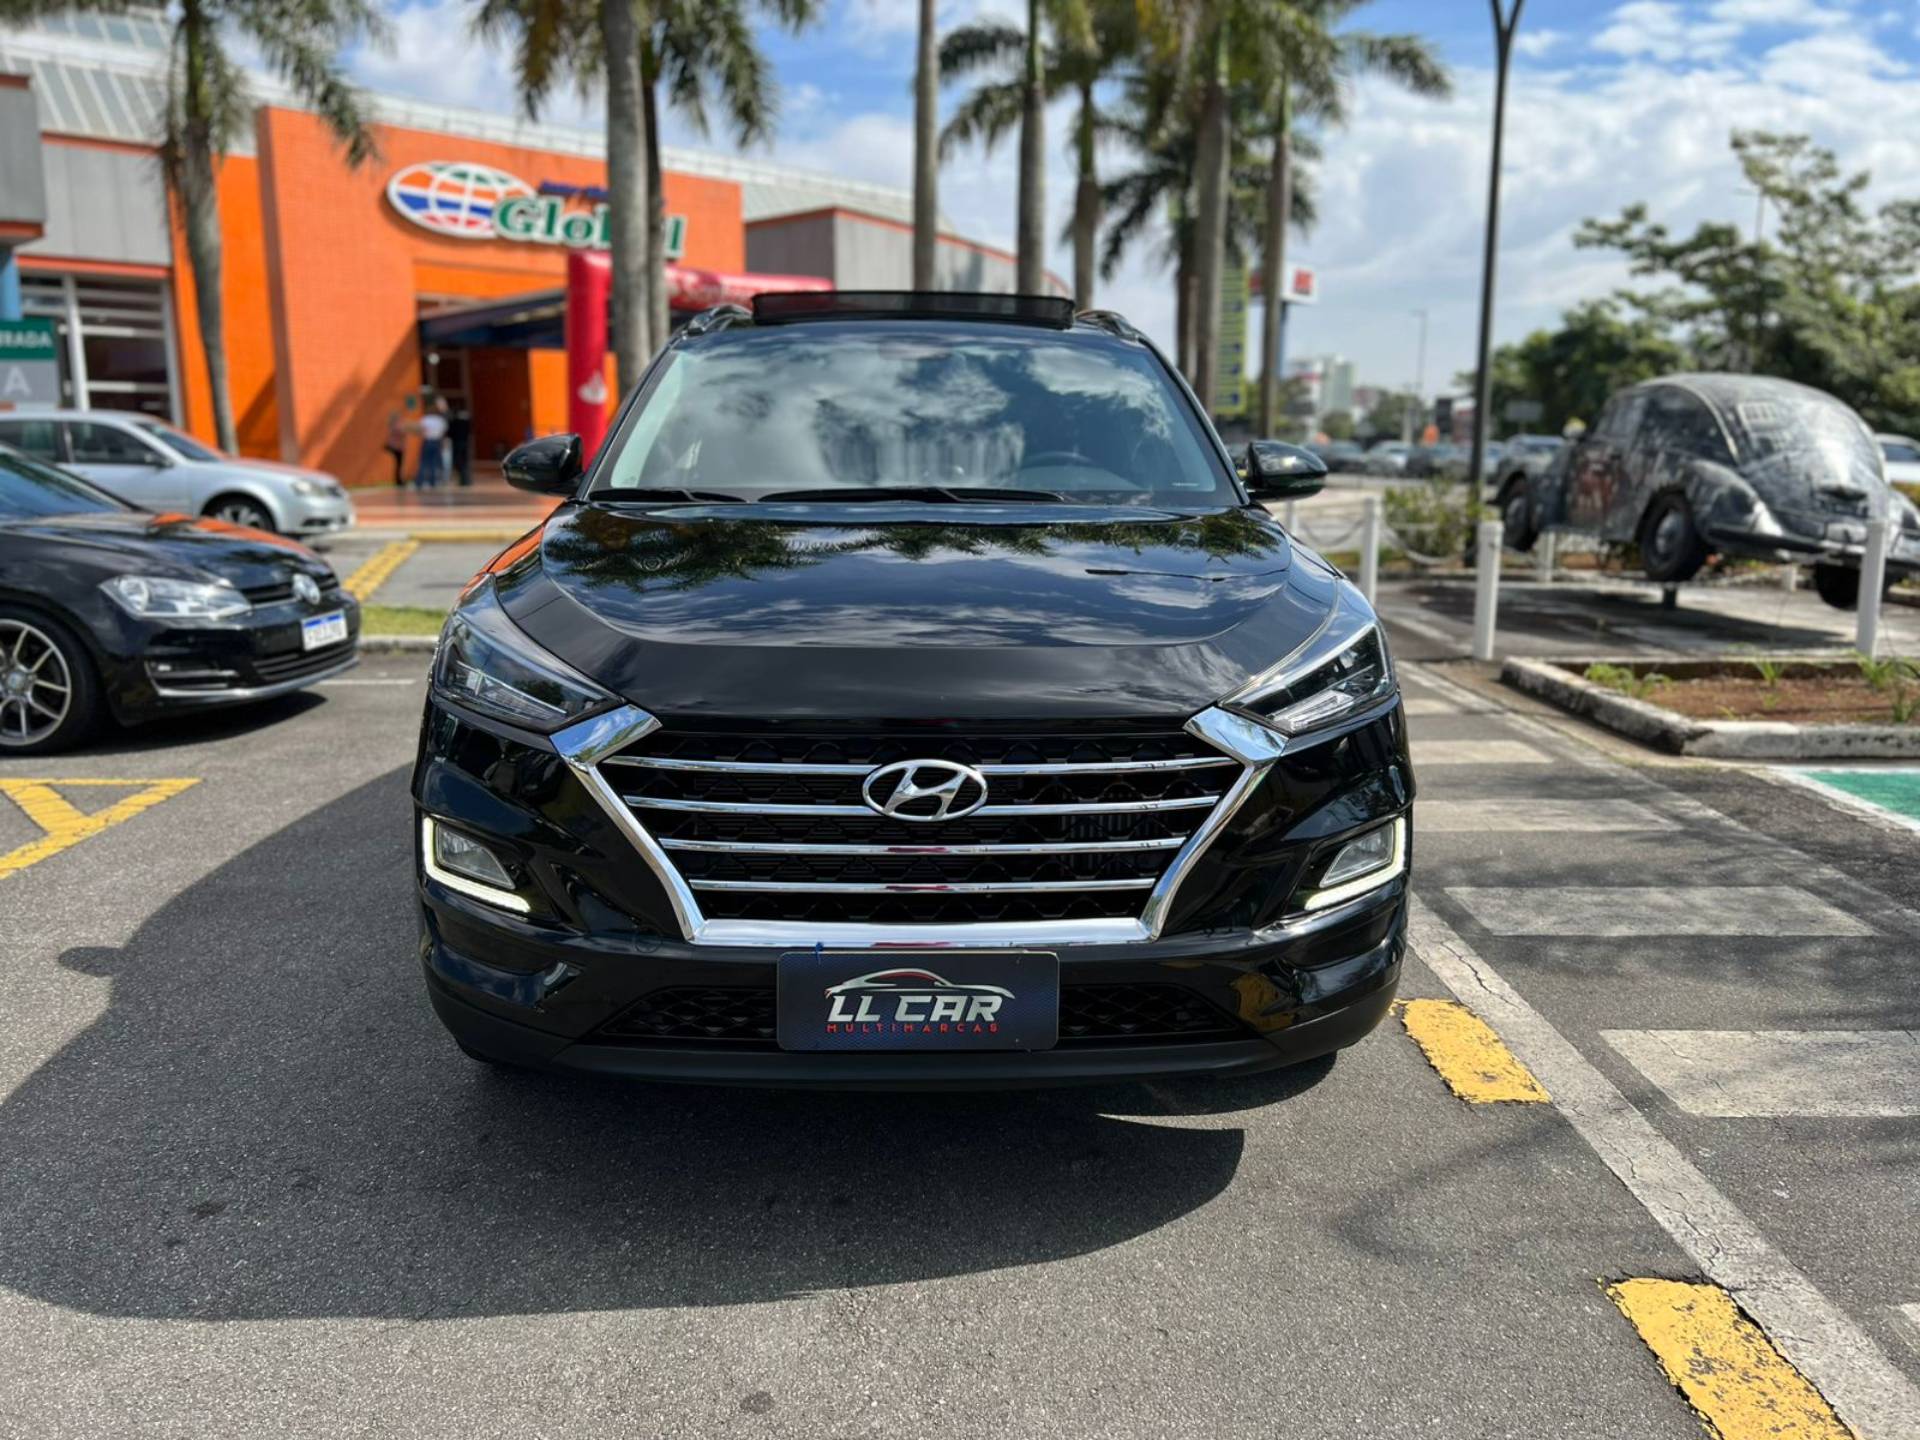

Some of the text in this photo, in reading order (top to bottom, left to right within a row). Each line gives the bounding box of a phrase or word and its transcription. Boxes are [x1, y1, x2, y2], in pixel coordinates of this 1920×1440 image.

[497, 198, 686, 256] Glol
[3, 365, 32, 397] A
[827, 995, 1003, 1022] LL CAR
[826, 1023, 999, 1033] MULTIMARCAS
